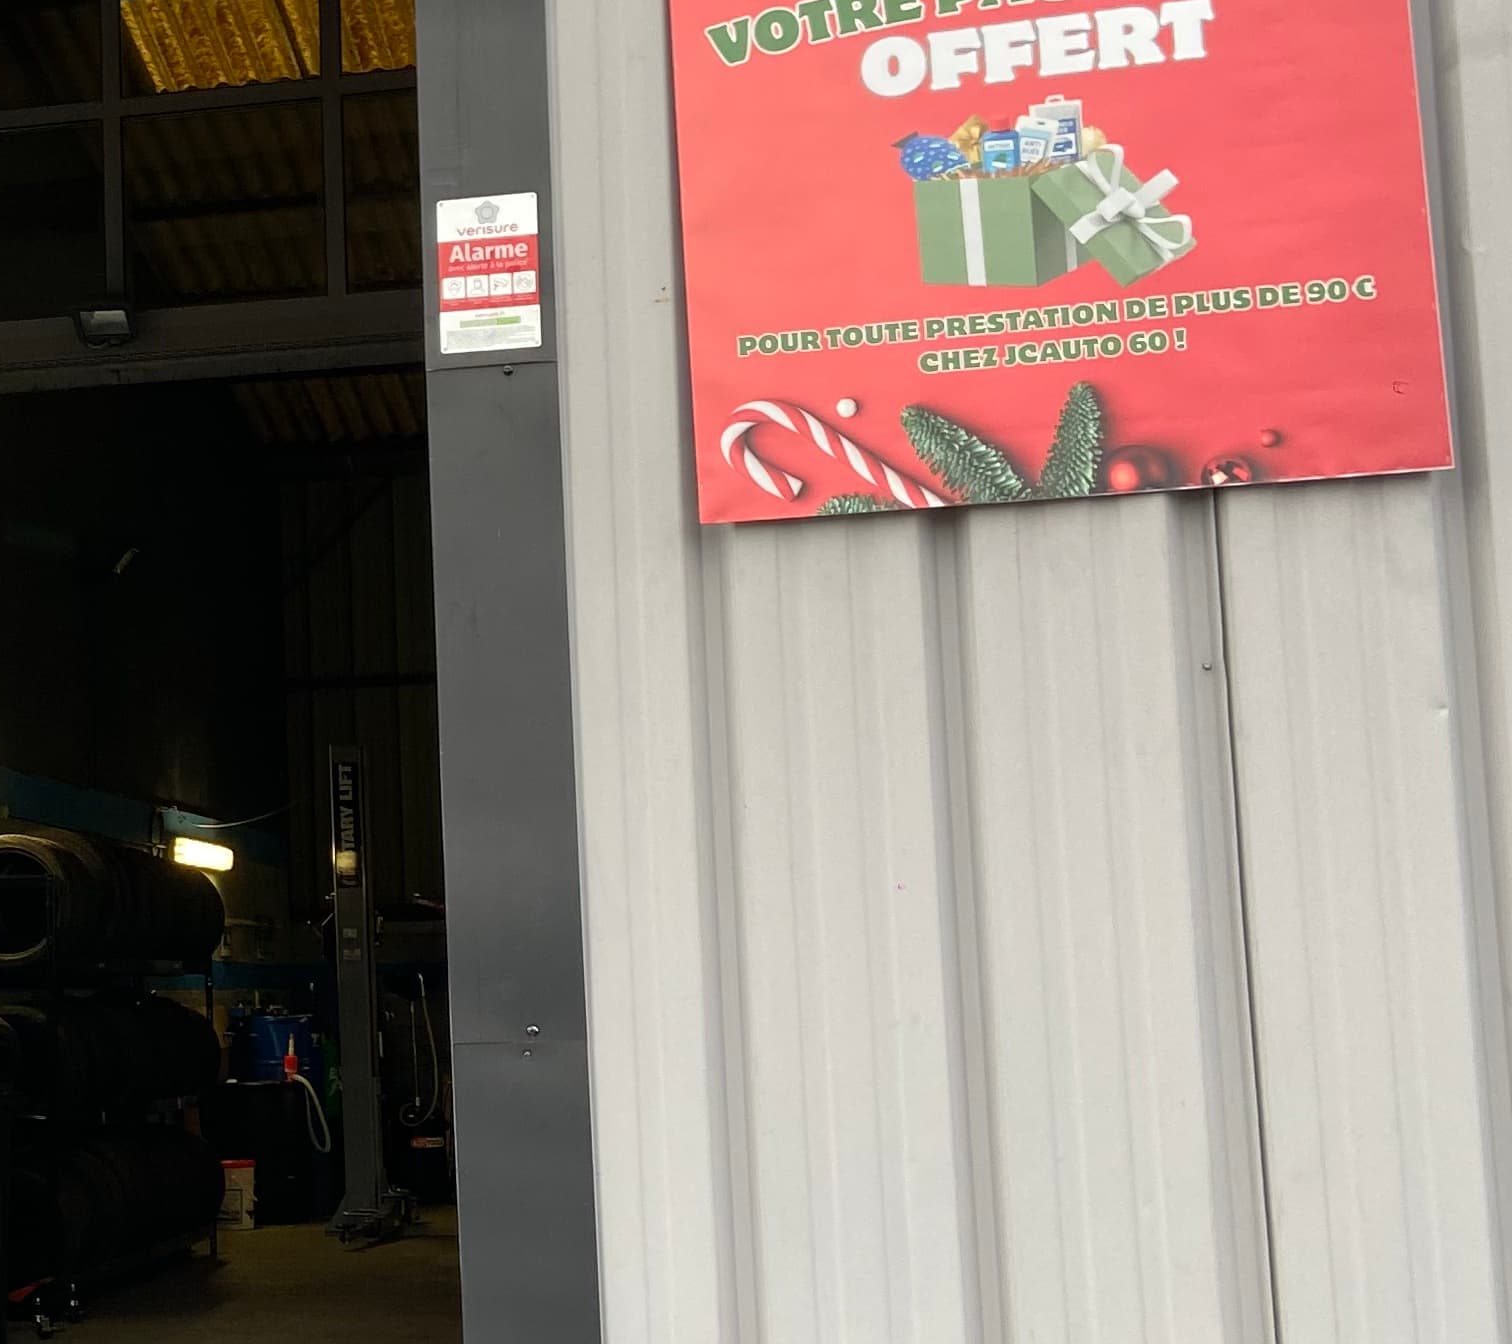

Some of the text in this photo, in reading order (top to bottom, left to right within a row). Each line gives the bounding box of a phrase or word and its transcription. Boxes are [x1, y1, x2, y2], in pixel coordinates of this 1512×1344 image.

[456, 223, 519, 236] verisure
[449, 242, 529, 263] Alarme
[737, 329, 822, 357] POUR
[825, 320, 919, 348] TOUTE
[925, 301, 1119, 340] PRESTATION
[1124, 296, 1168, 320] DE
[1173, 287, 1252, 316] PLUS
[1257, 283, 1302, 308] DE
[1305, 278, 1350, 303] 90
[918, 346, 999, 374] CHEZ
[1002, 335, 1123, 366] JCAUTO
[1127, 330, 1169, 354] 60
[338, 763, 353, 801] LIFT
